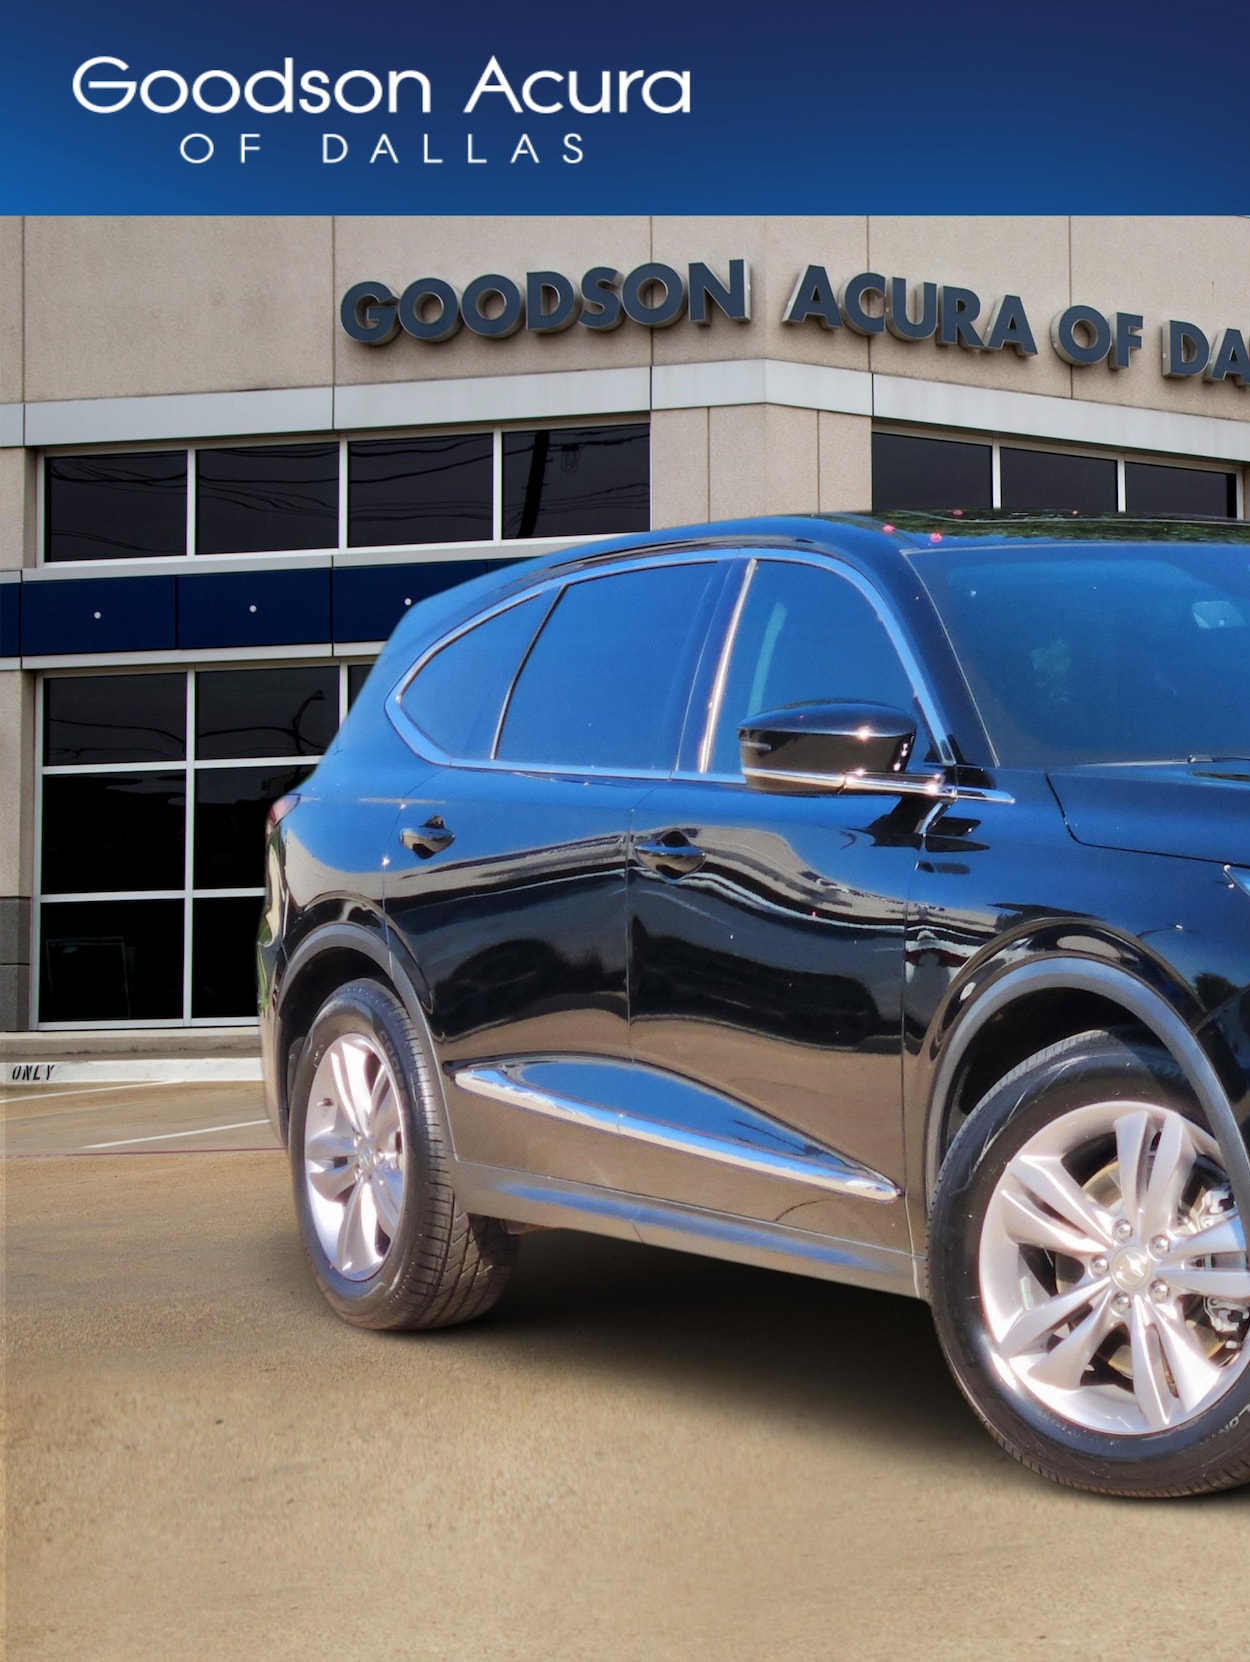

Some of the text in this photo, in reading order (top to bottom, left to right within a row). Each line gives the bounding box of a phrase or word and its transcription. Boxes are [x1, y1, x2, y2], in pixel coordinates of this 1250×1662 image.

[340, 259, 751, 345] GOODSON
[782, 264, 1038, 356] ACURA
[1051, 305, 1143, 369] OF
[11, 1064, 55, 1081] ONLY
